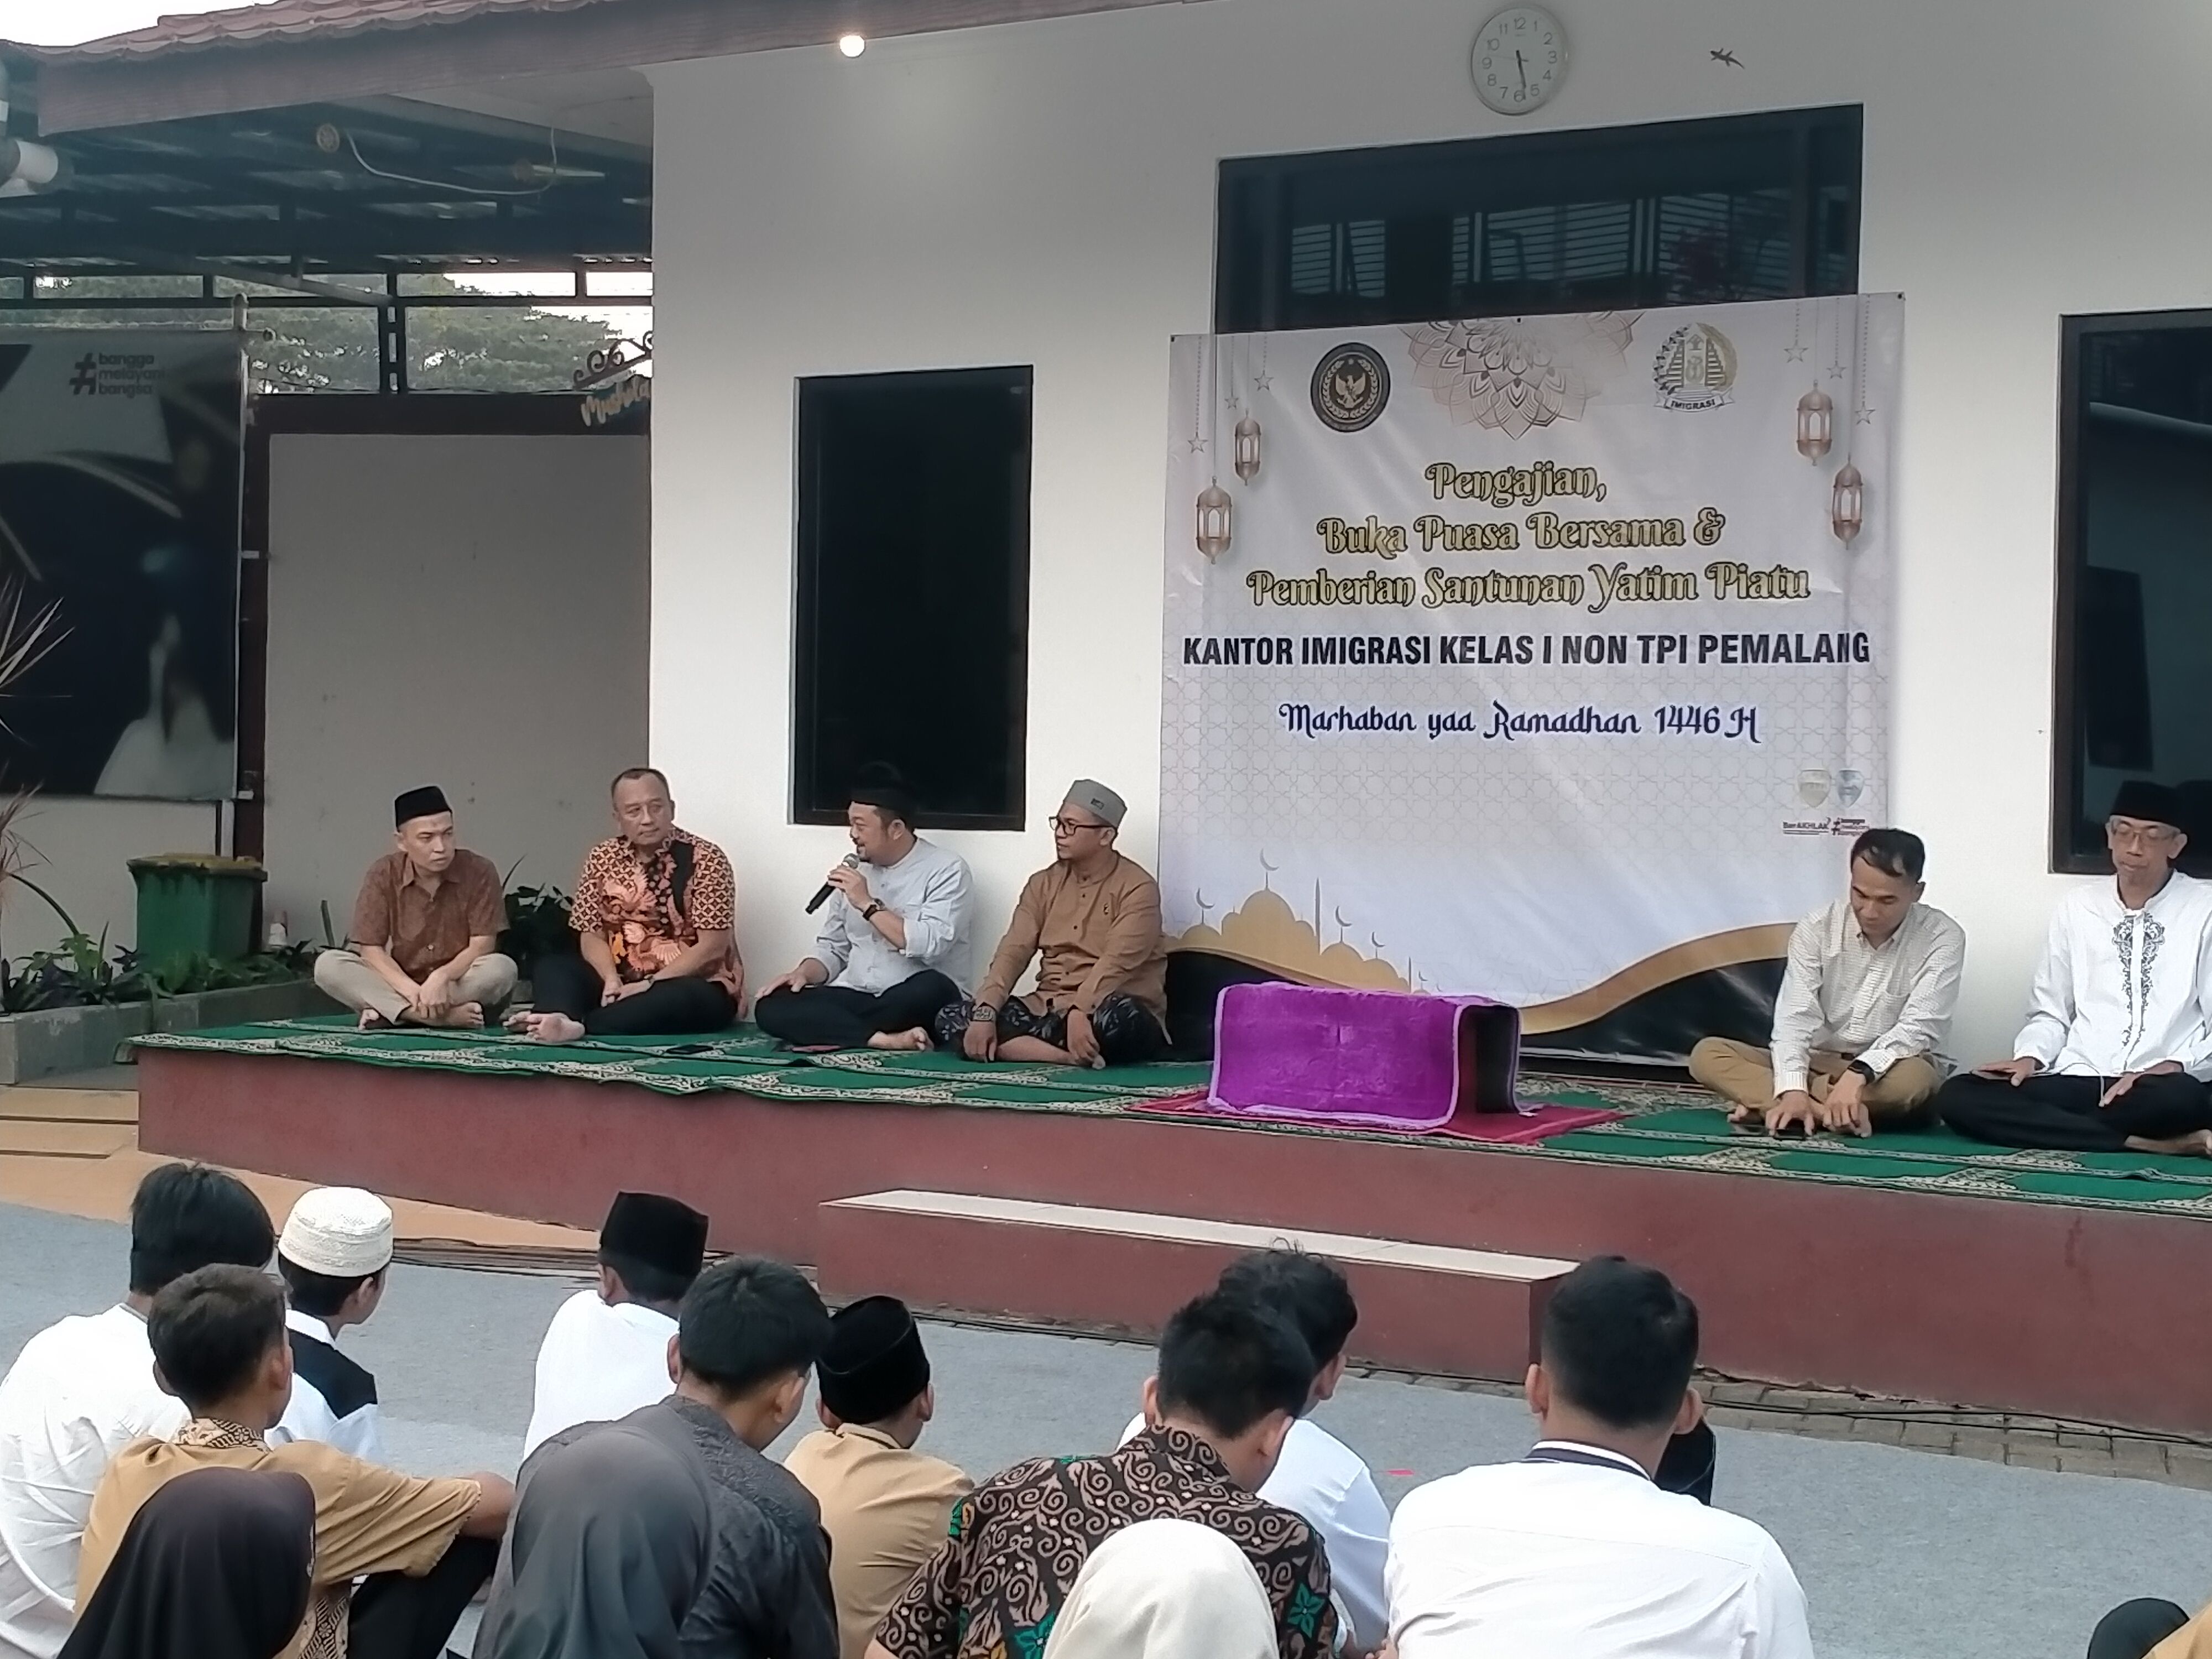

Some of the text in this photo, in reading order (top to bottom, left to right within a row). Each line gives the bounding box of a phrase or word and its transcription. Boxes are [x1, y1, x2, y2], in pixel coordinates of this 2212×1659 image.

[1499, 23, 1507, 35] 11
[1514, 17, 1526, 30] 12
[1487, 38, 1499, 50] 10
[1543, 32, 1552, 45] 2
[1482, 57, 1491, 69] 9
[1548, 50, 1557, 64] 3
[1487, 74, 1496, 86] 8
[1542, 70, 1551, 81] 4
[1499, 86, 1508, 98] 7
[1514, 90, 1524, 102] 6
[1530, 84, 1540, 96] 5
[99, 353, 155, 368] bangga
[99, 384, 152, 398] bangsa
[1671, 399, 1716, 410] IMIGRASI
[1425, 461, 1607, 508] Pengajian,
[1317, 507, 1725, 560] Buka Puasa Bersama &
[1246, 562, 1811, 613] Pemberian Santunan Yatim Piatu
[1183, 633, 1870, 665] KANTOR IMIGRASI KELAS I NON TPI PEMALANG
[1279, 703, 1417, 738] Marhaban
[1428, 711, 1477, 740] yaa
[1483, 700, 1641, 740] Ramadhan
